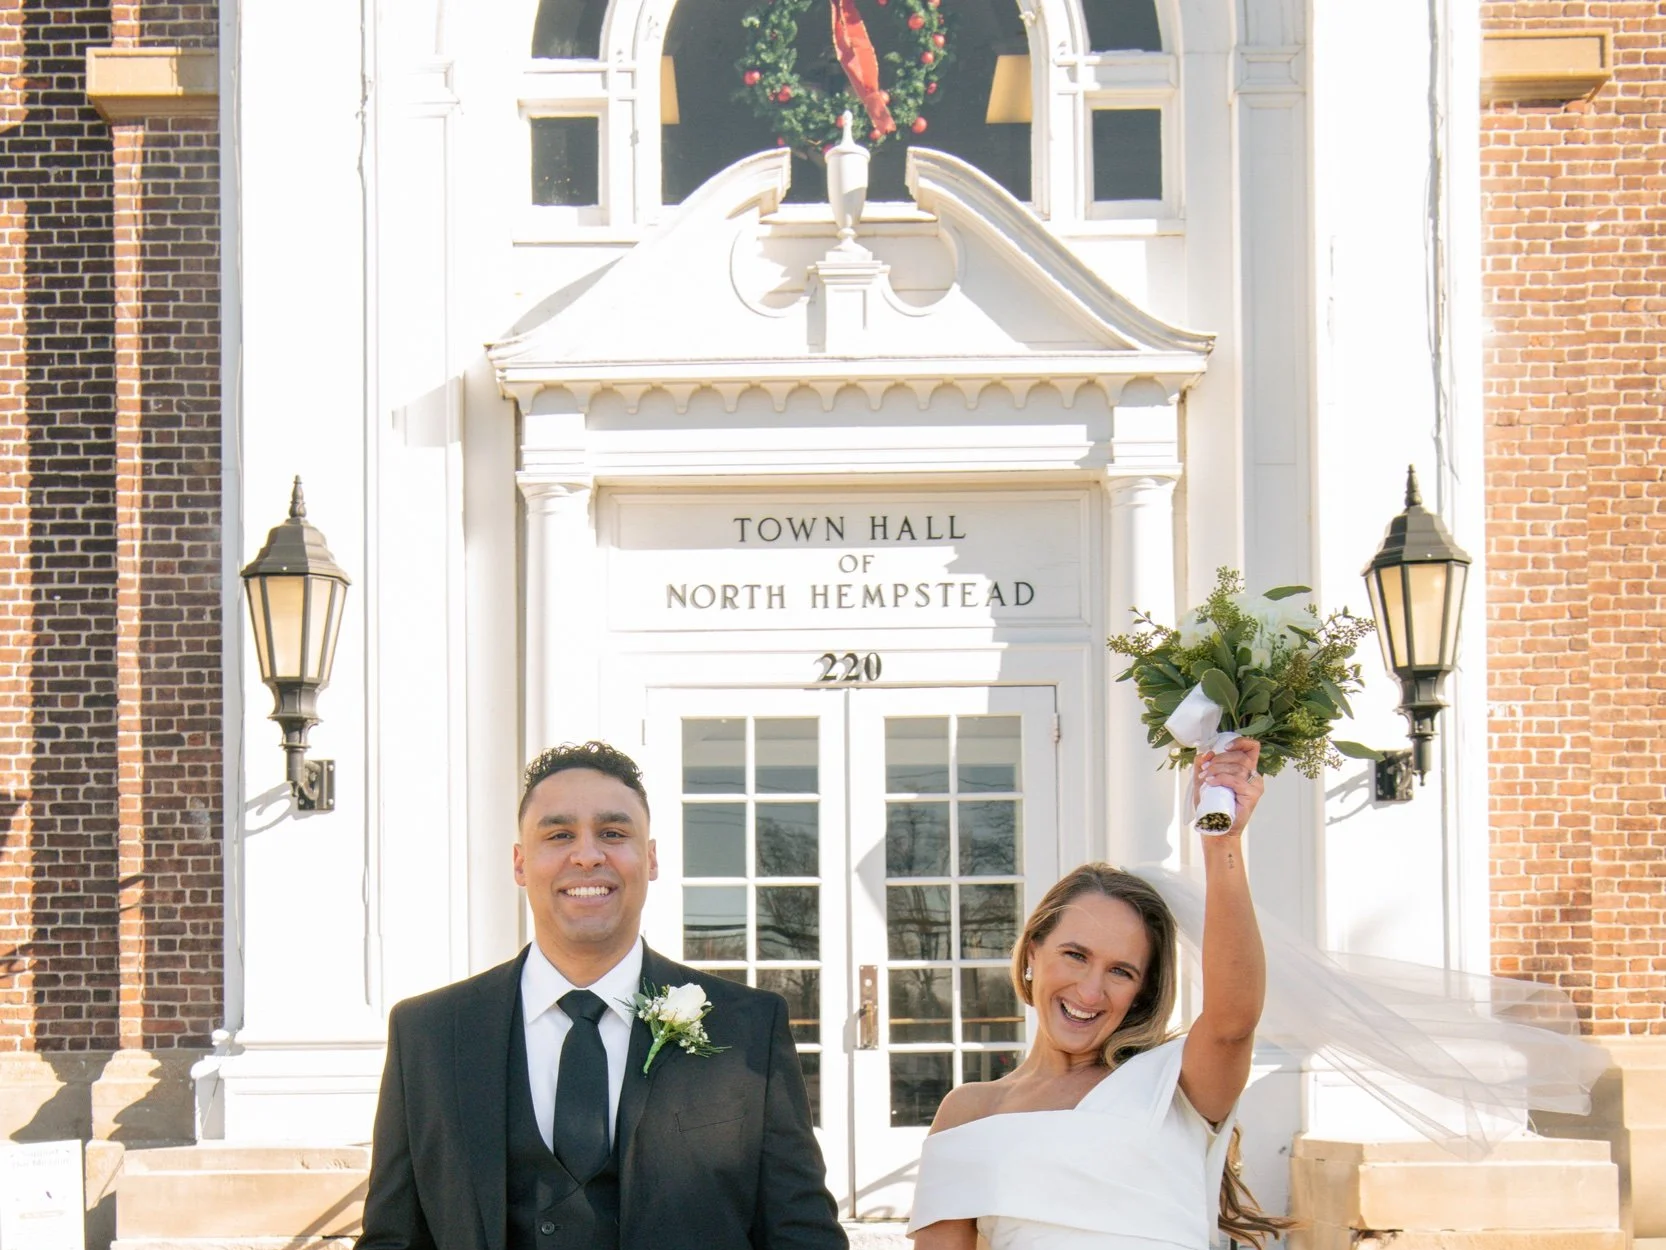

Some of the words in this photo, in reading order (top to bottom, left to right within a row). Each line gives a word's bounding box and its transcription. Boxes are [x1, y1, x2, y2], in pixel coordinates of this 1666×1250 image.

[733, 517, 845, 542] TOWN
[870, 515, 967, 540] HALL
[838, 553, 875, 573] OF
[666, 584, 786, 610] NORTH
[811, 582, 1035, 608] HEMPSTEAD
[819, 651, 882, 682] 220
